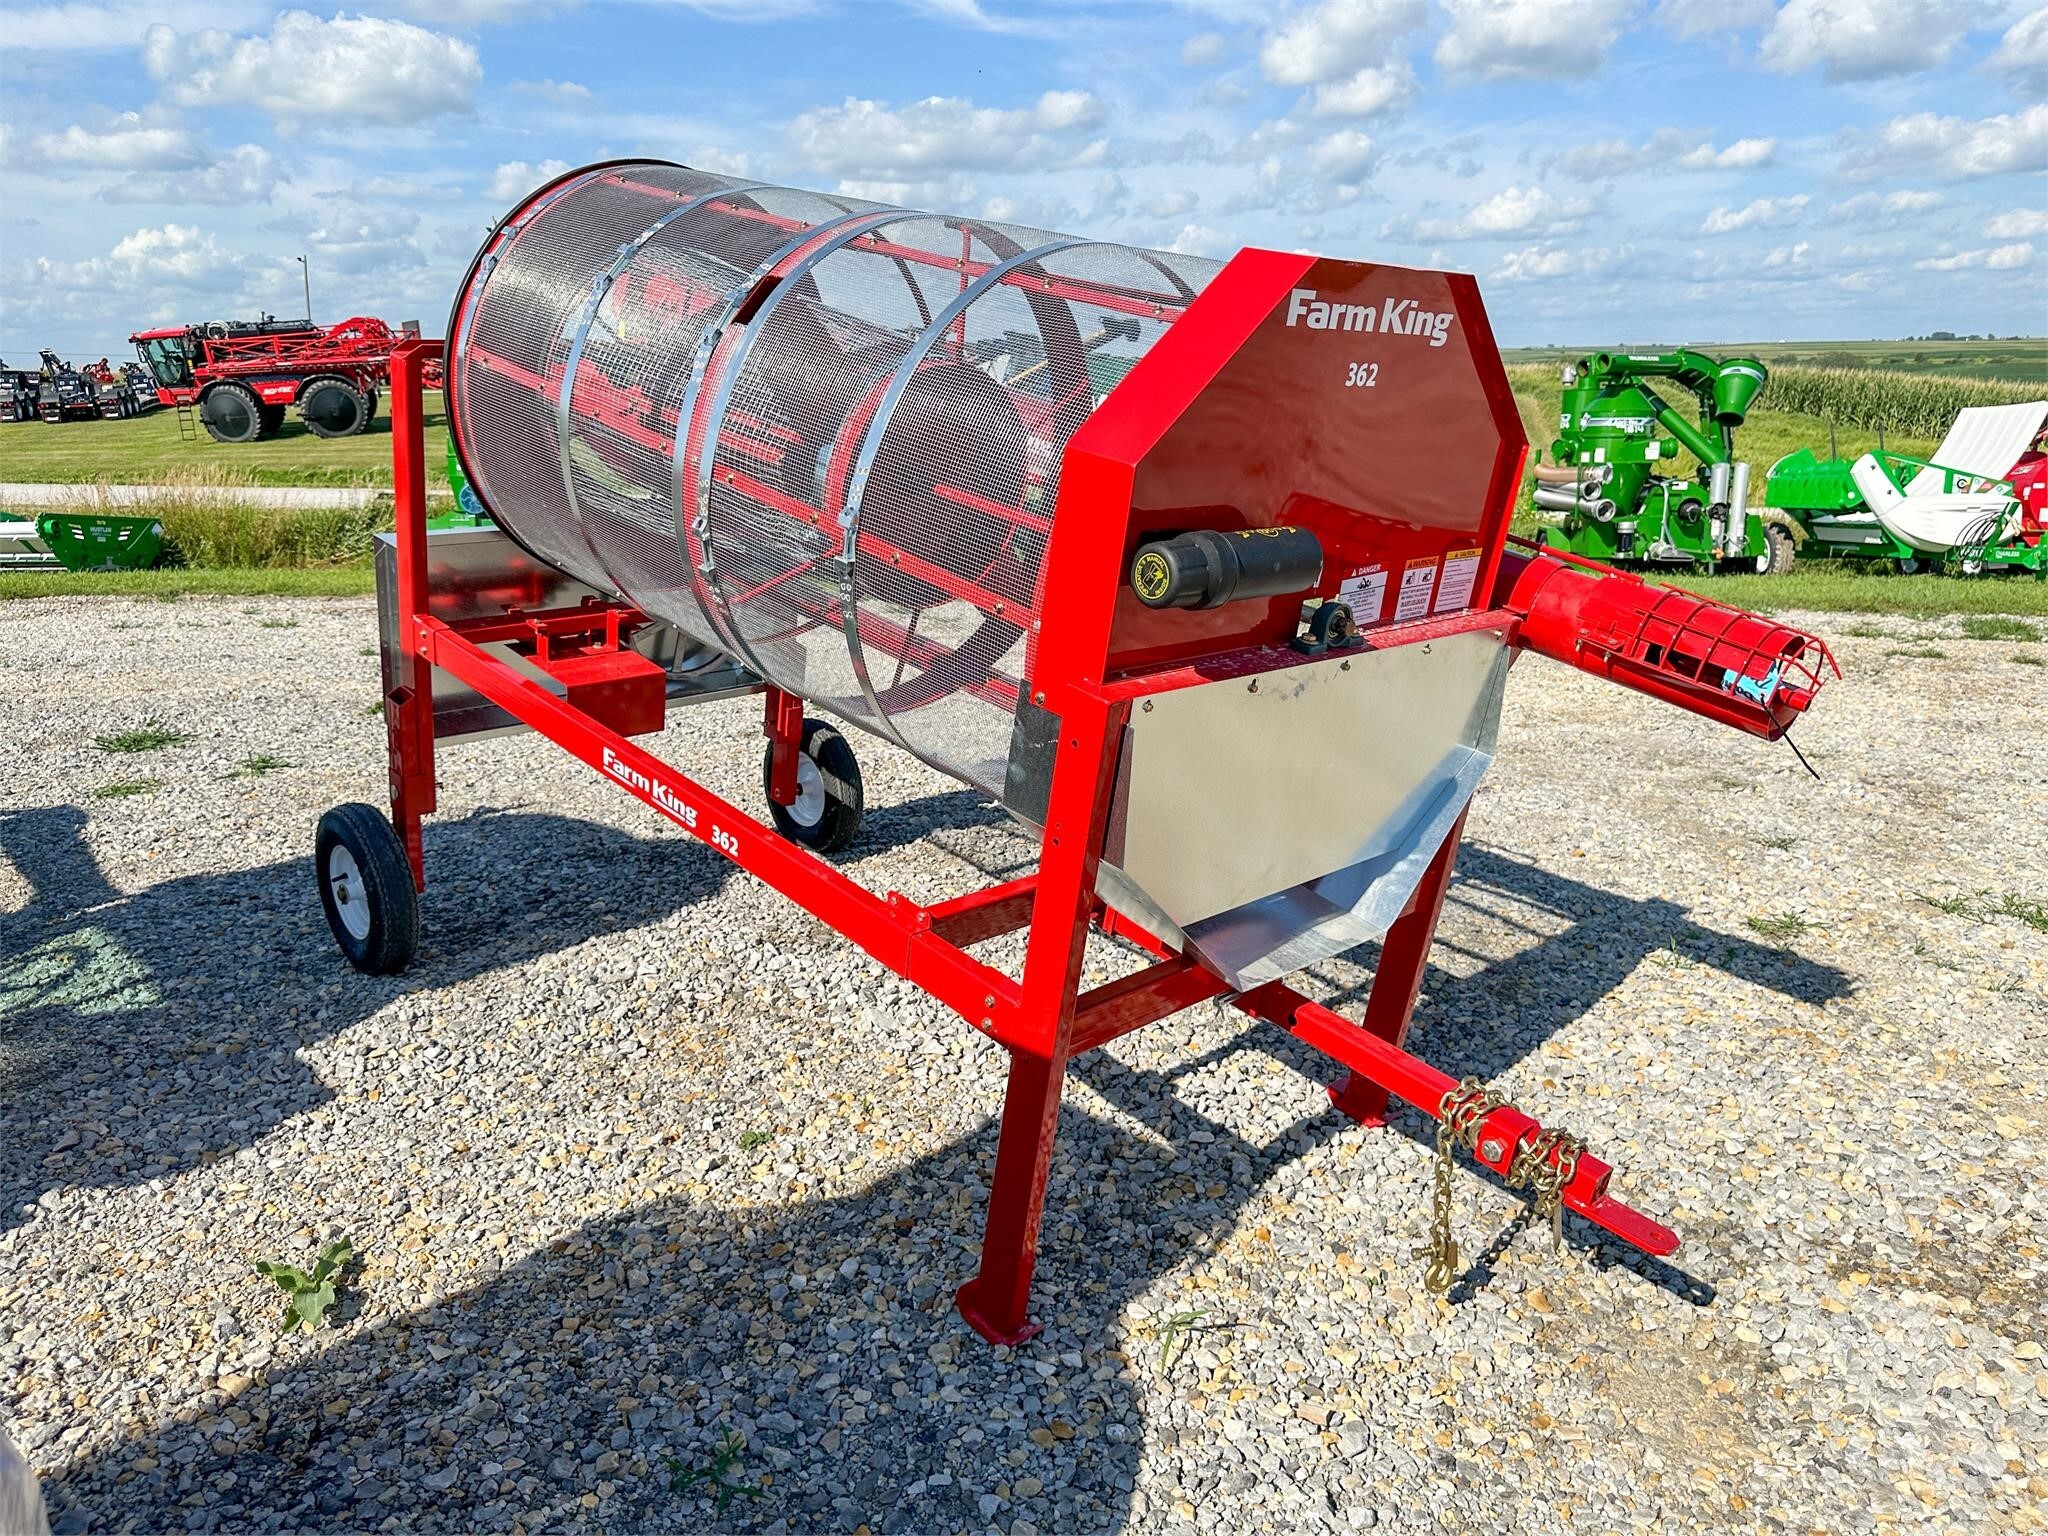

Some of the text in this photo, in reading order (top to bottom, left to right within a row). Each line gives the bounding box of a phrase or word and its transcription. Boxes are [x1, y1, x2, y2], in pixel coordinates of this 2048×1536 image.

[1286, 288, 1454, 347] Farm King
[1345, 362, 1379, 387] 362
[1146, 555, 1165, 569] MANUAL
[1358, 564, 1382, 575] DANGER
[1413, 558, 1437, 568] WARNING
[603, 746, 739, 858] Farm King 362
